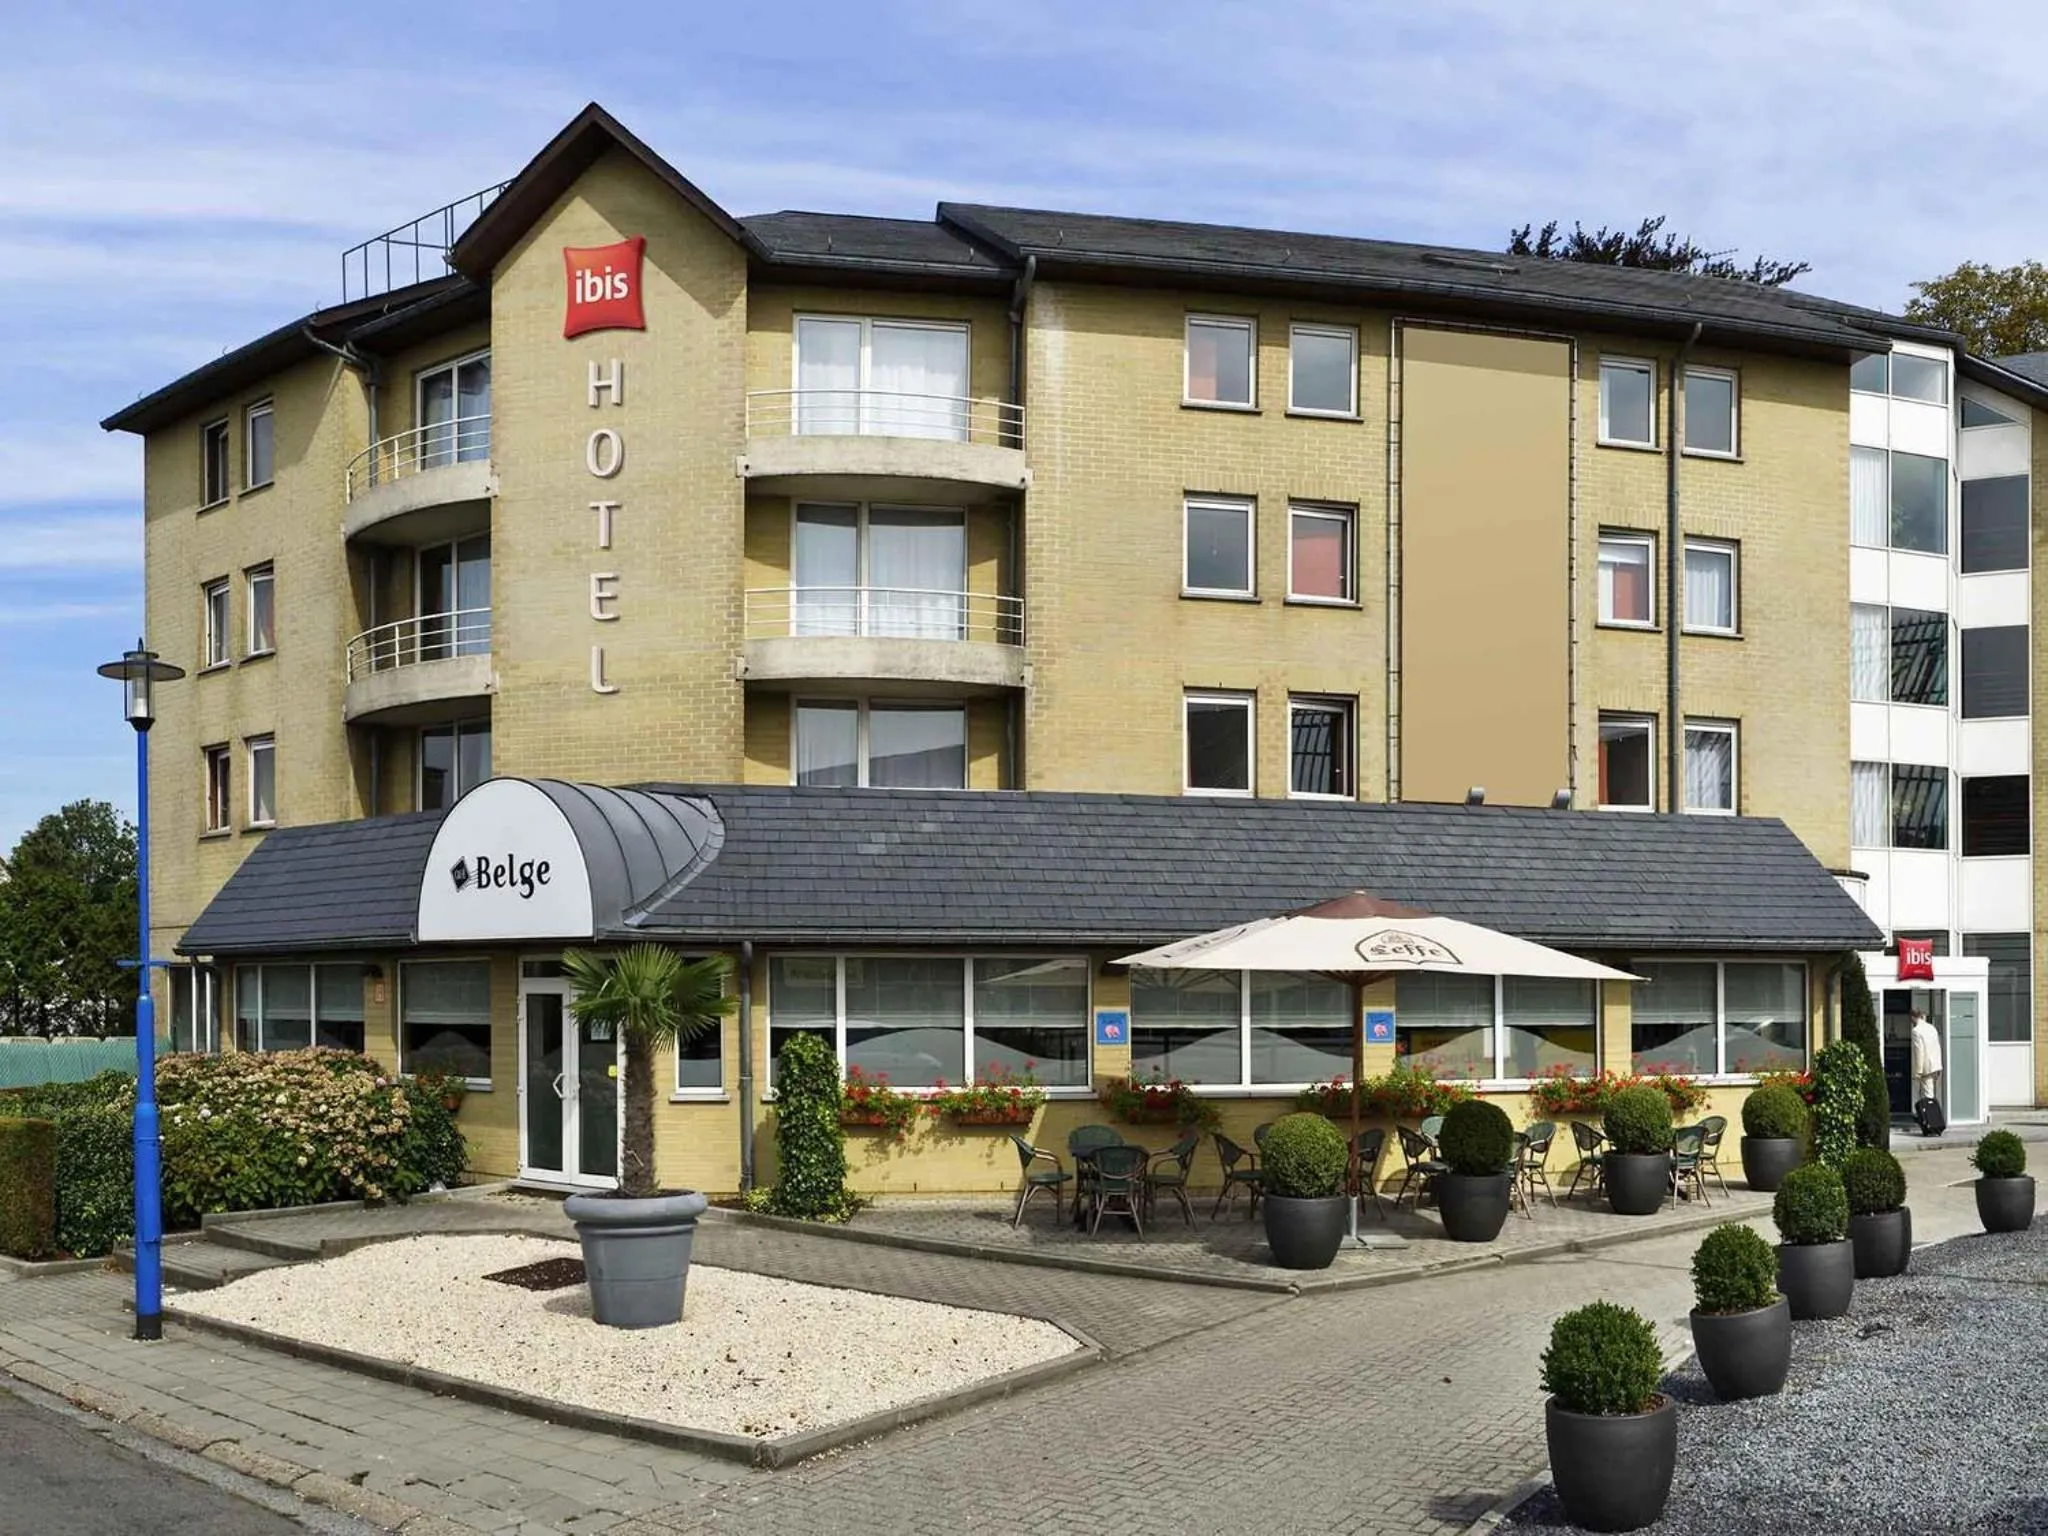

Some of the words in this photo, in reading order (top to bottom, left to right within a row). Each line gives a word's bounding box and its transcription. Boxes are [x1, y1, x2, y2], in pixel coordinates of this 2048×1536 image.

[575, 265, 629, 305] ibis
[586, 359, 623, 694] HOTEL
[476, 853, 551, 900] Belge
[1906, 947, 1932, 965] ibis
